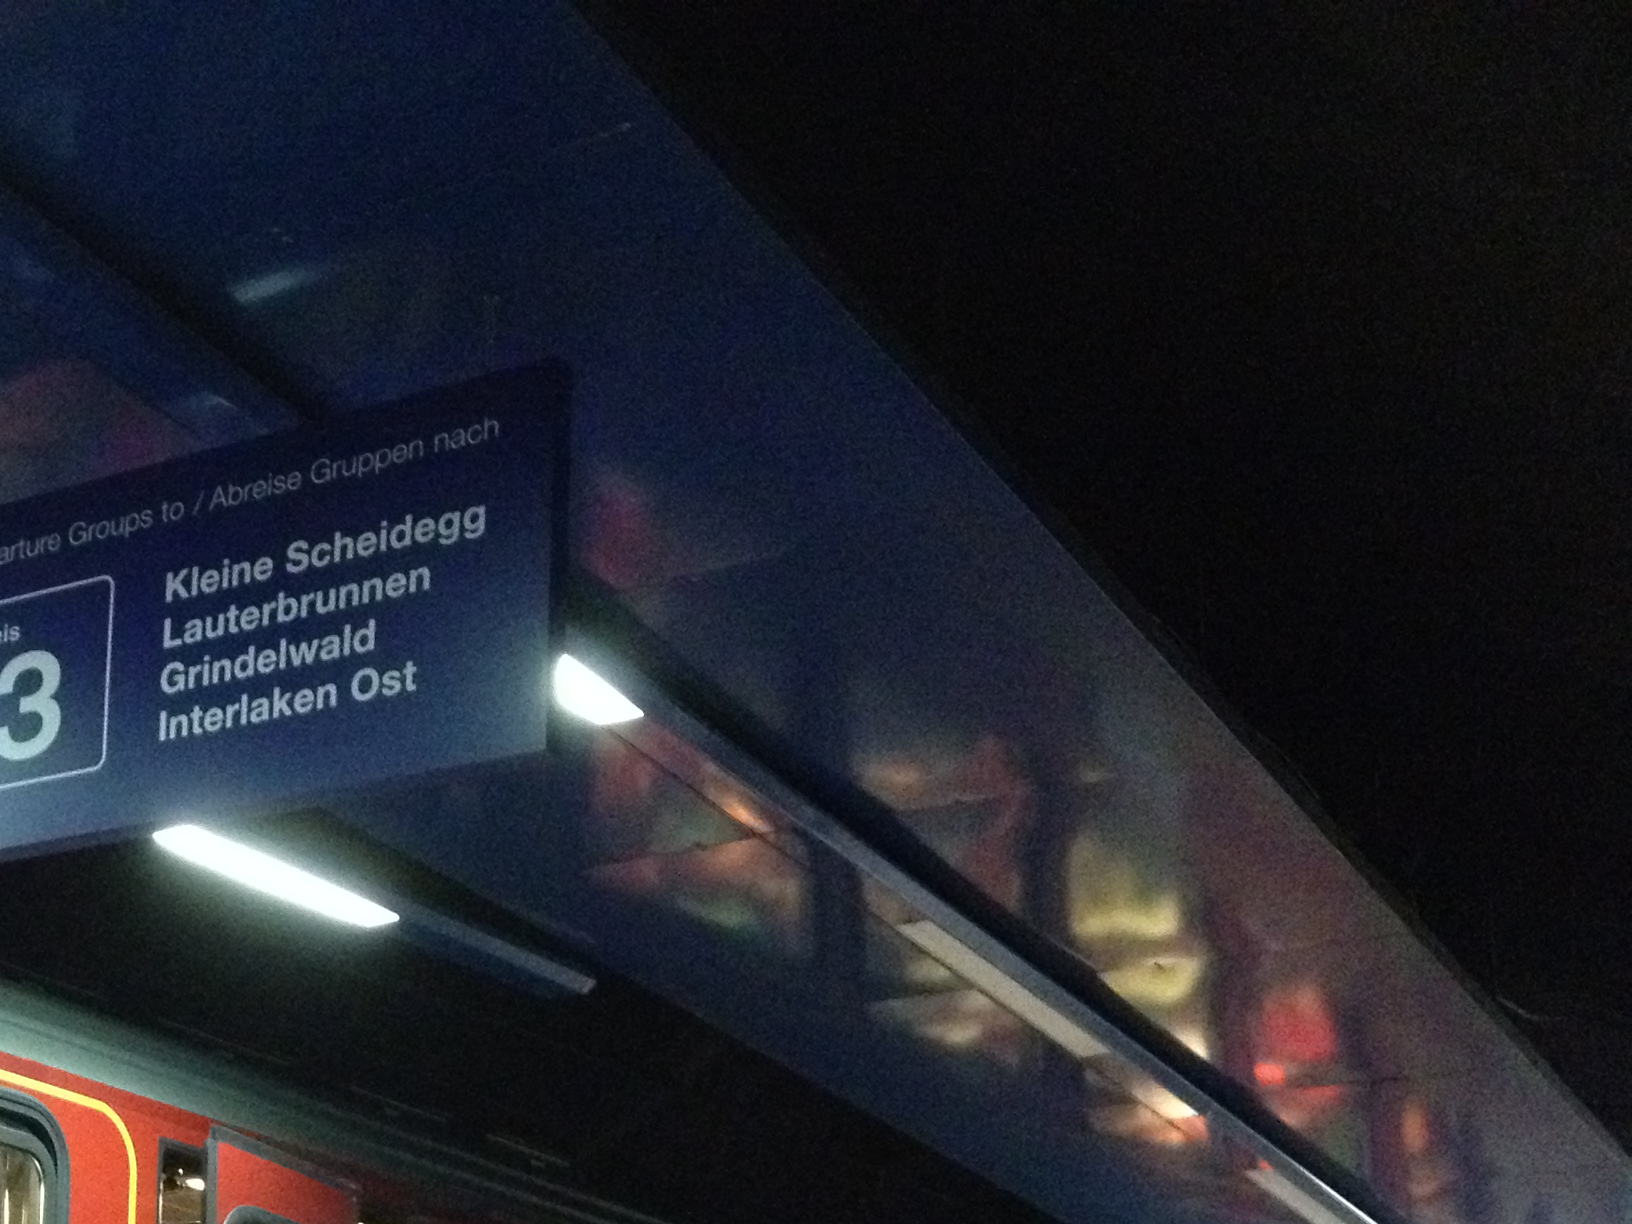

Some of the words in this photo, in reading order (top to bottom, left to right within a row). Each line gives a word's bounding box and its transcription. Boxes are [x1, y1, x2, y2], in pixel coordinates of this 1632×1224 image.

[68, 508, 153, 546] Groups
[162, 500, 185, 522] to
[209, 471, 302, 511] Abreise
[310, 439, 424, 484] Gruppen
[434, 417, 500, 452] nach
[165, 556, 274, 603] Kleine
[286, 504, 487, 574] Scheidegg
[163, 566, 432, 649] Lauterbrunnen
[159, 618, 377, 694] Grindelwald
[158, 682, 338, 741] Interlaken
[350, 660, 418, 702] Ost
